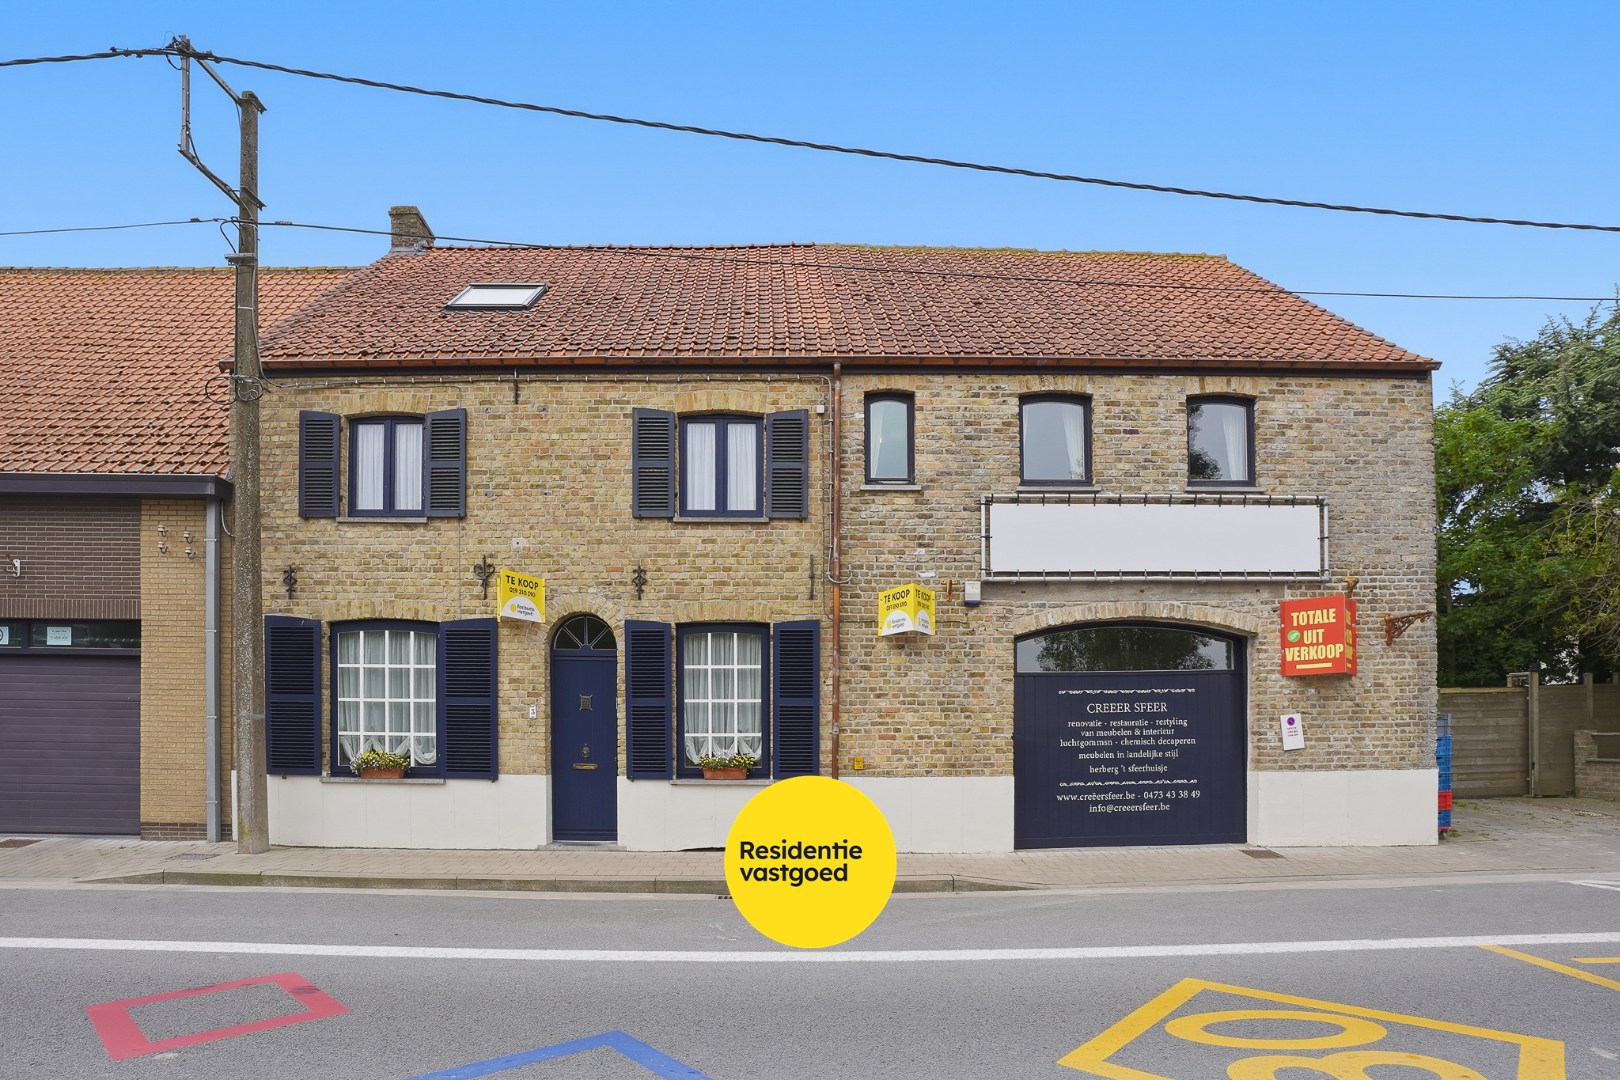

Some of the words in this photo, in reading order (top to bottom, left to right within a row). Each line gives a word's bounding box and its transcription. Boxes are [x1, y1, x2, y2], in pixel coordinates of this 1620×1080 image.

[506, 575, 515, 585] TE
[518, 578, 539, 590] KOOP
[884, 594, 891, 603] TE
[892, 589, 910, 601] KOOP
[1291, 608, 1336, 626] TOTALE
[1303, 629, 1325, 644] UIT
[1285, 643, 1344, 661] VERKOOP
[1086, 703, 1132, 714] CREEER
[1133, 702, 1168, 713] SFEER
[1067, 719, 1103, 728] renovatie
[1109, 718, 1149, 727] restauratie
[1155, 717, 1188, 728] restyling
[1096, 728, 1132, 737] meubelen
[1134, 728, 1141, 736] &
[1142, 727, 1175, 736] interieur
[1120, 736, 1156, 746] chemisch
[1157, 736, 1197, 747] decaperen
[1078, 750, 1115, 760] meubelen
[1116, 750, 1125, 759] in
[1126, 749, 1164, 760] landelijke
[1164, 748, 1179, 760] stijl
[1089, 764, 1119, 776] herberg
[1127, 763, 1168, 774] sfeerhuisje
[1143, 790, 1164, 800] 0473
[1165, 790, 1176, 799] 43
[1177, 789, 1189, 799] 38
[1190, 789, 1201, 799] 49
